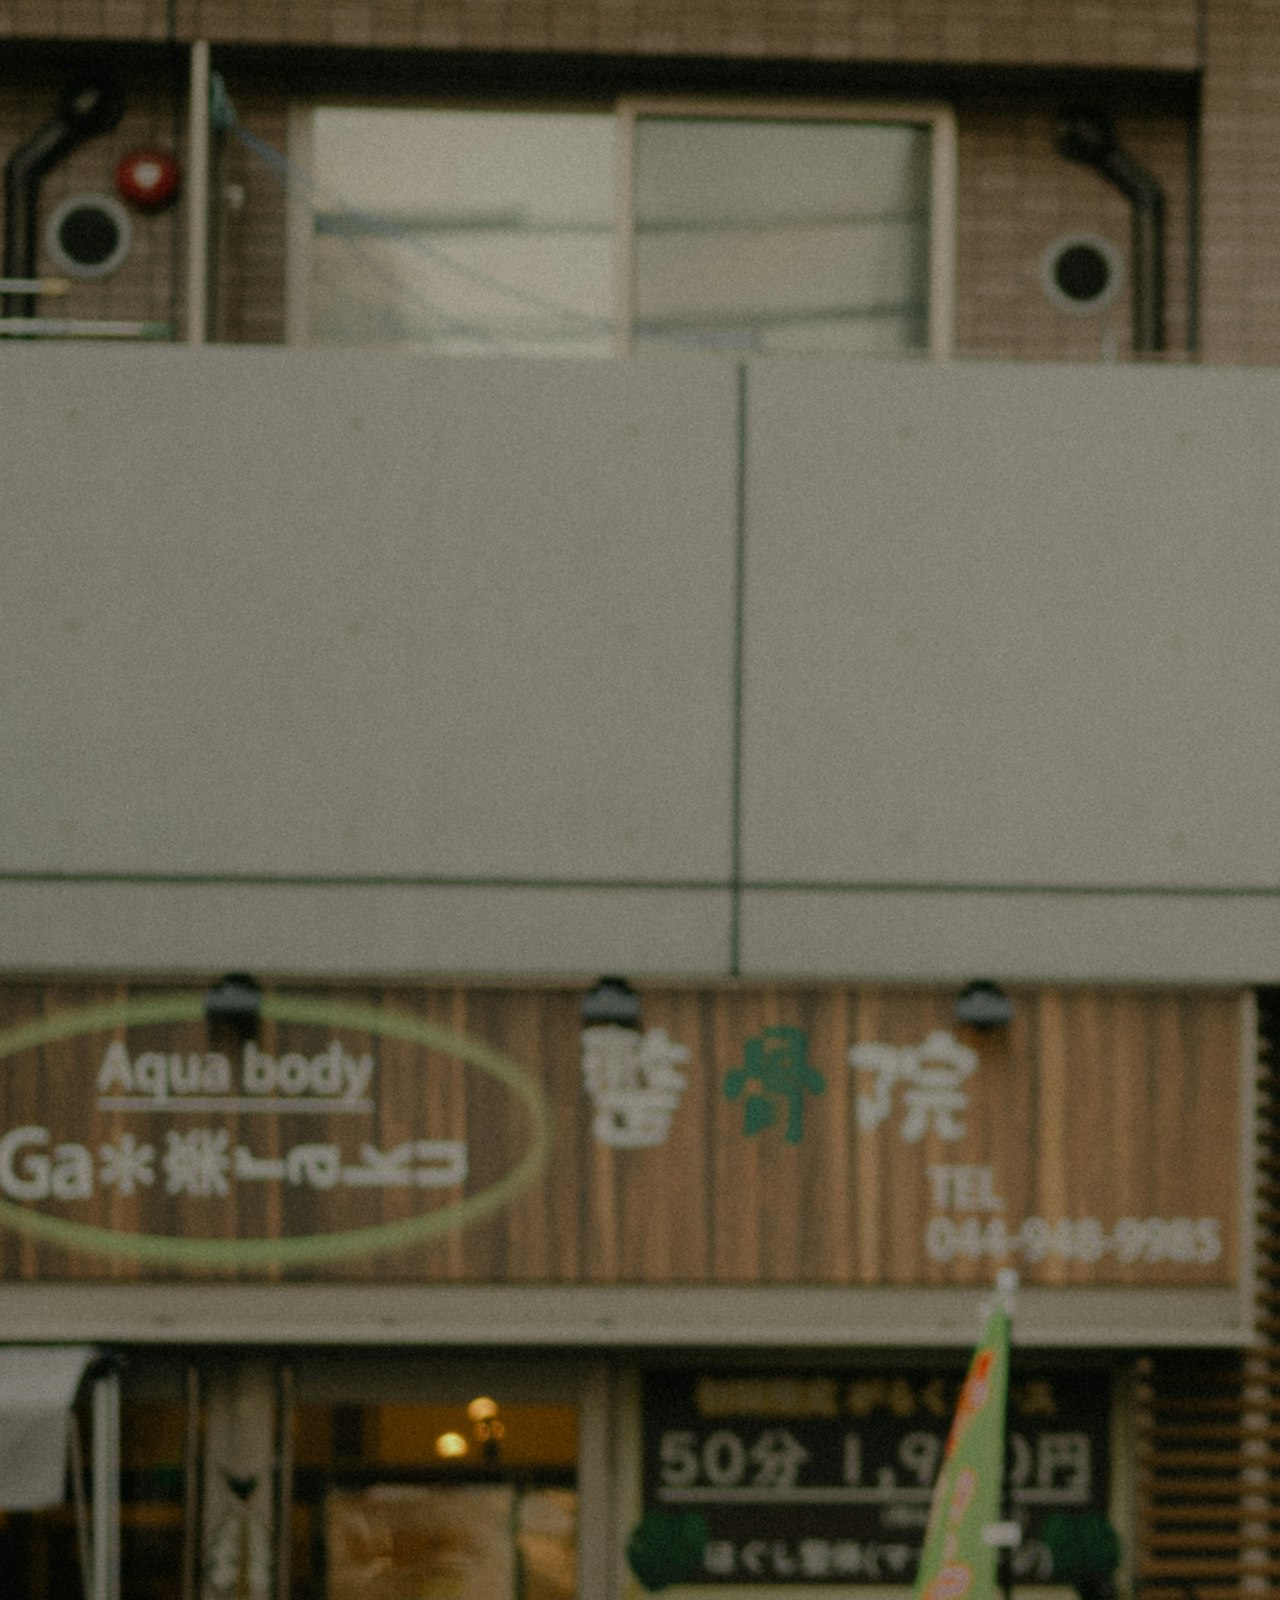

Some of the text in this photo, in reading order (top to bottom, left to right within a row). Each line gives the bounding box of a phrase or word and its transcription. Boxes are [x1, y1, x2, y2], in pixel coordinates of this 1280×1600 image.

[97, 1041, 374, 1103] Aqua body
[926, 1163, 1004, 1212] TEL
[926, 1217, 1222, 1263] 044-948-9985
[659, 1429, 1091, 1492] 50分 1,9円
